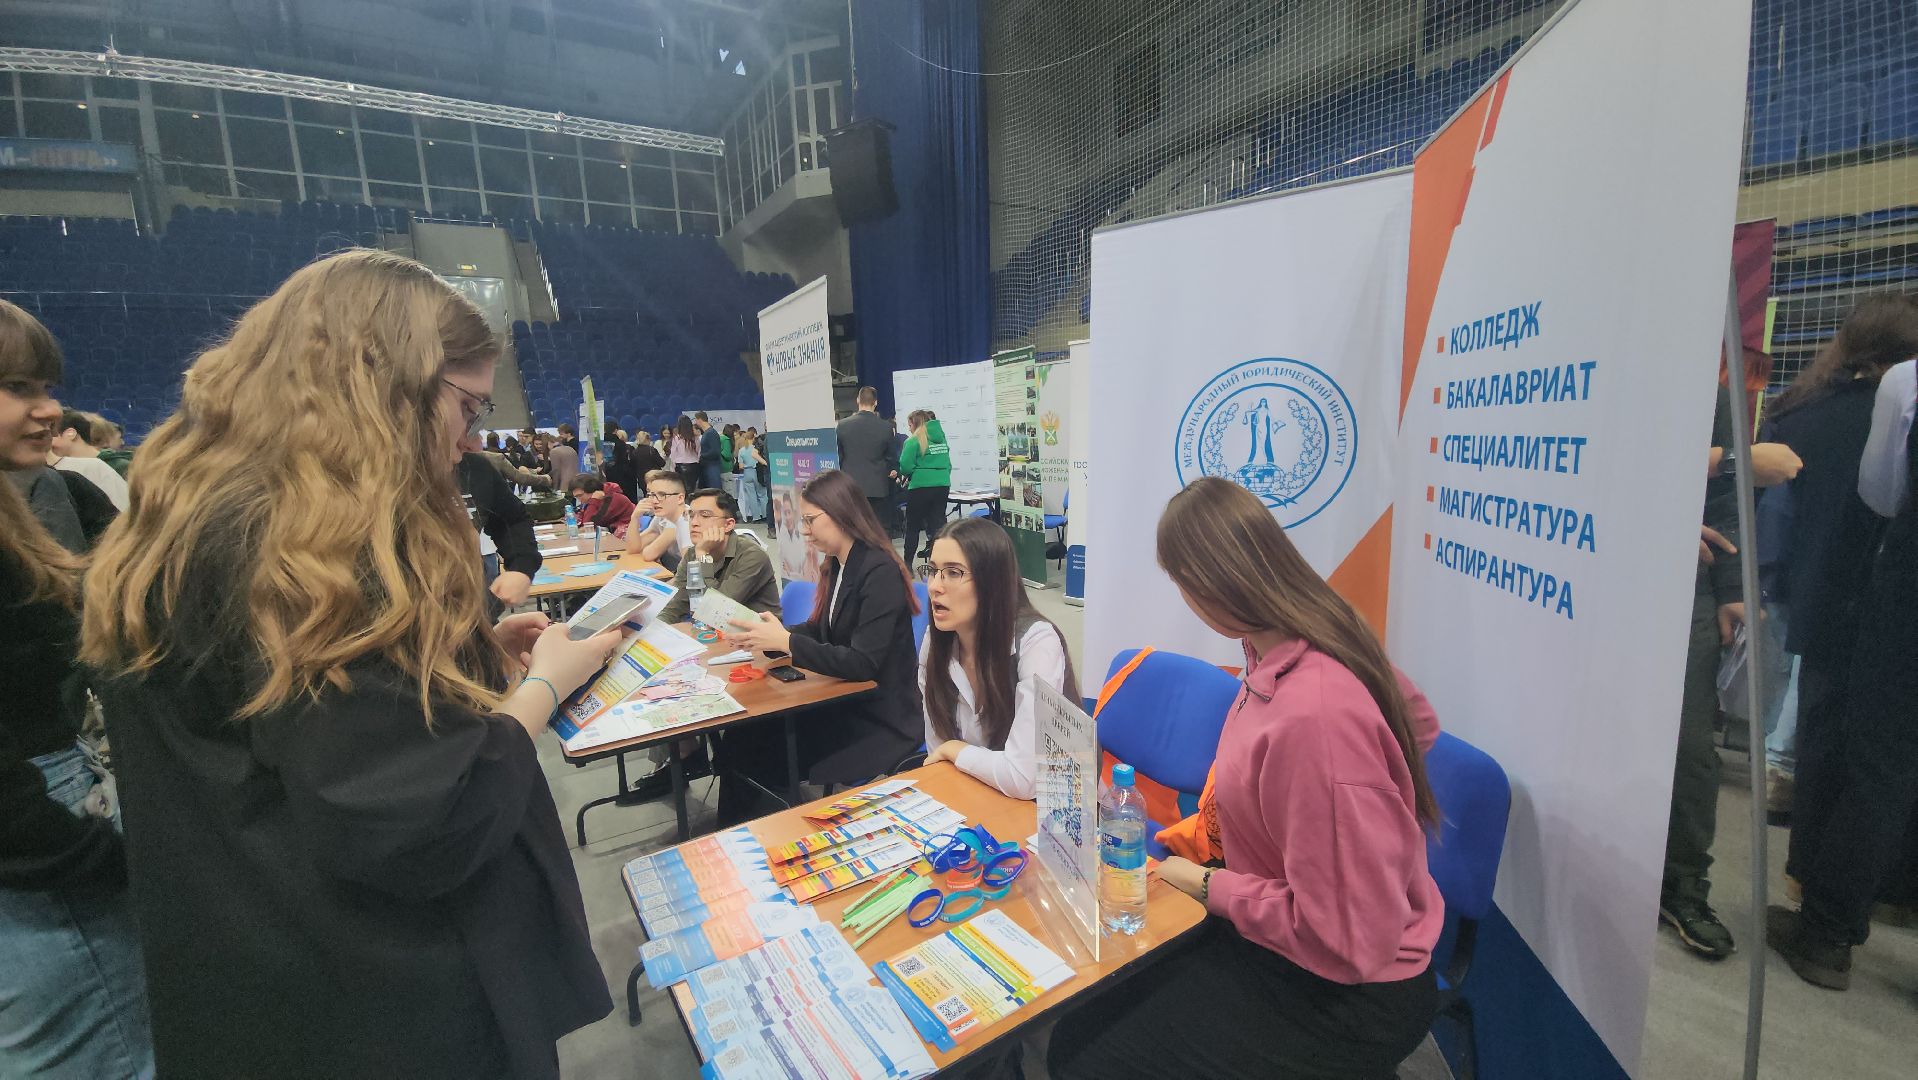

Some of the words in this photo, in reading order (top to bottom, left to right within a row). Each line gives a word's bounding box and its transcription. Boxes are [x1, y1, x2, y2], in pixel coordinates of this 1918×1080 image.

[775, 346, 797, 373] НОВЫЕ
[797, 336, 826, 366] ЗНАНИЯ
[1450, 301, 1542, 356] КОЛЛЕДЖ
[1447, 361, 1597, 410] БАКАЛАВРИАТ
[1183, 373, 1241, 469] МЕЖДУНАРОДНЫЙ
[1242, 366, 1333, 401] ЮРИДИЧЕСКИЙ
[1326, 399, 1347, 467] ИНСТИТУТ
[1443, 434, 1587, 475] СПЕЦИАЛИТЕТ
[1439, 486, 1596, 553] МАГИСТРАТУРА
[1435, 537, 1574, 620] АСПИРАНТУРА
